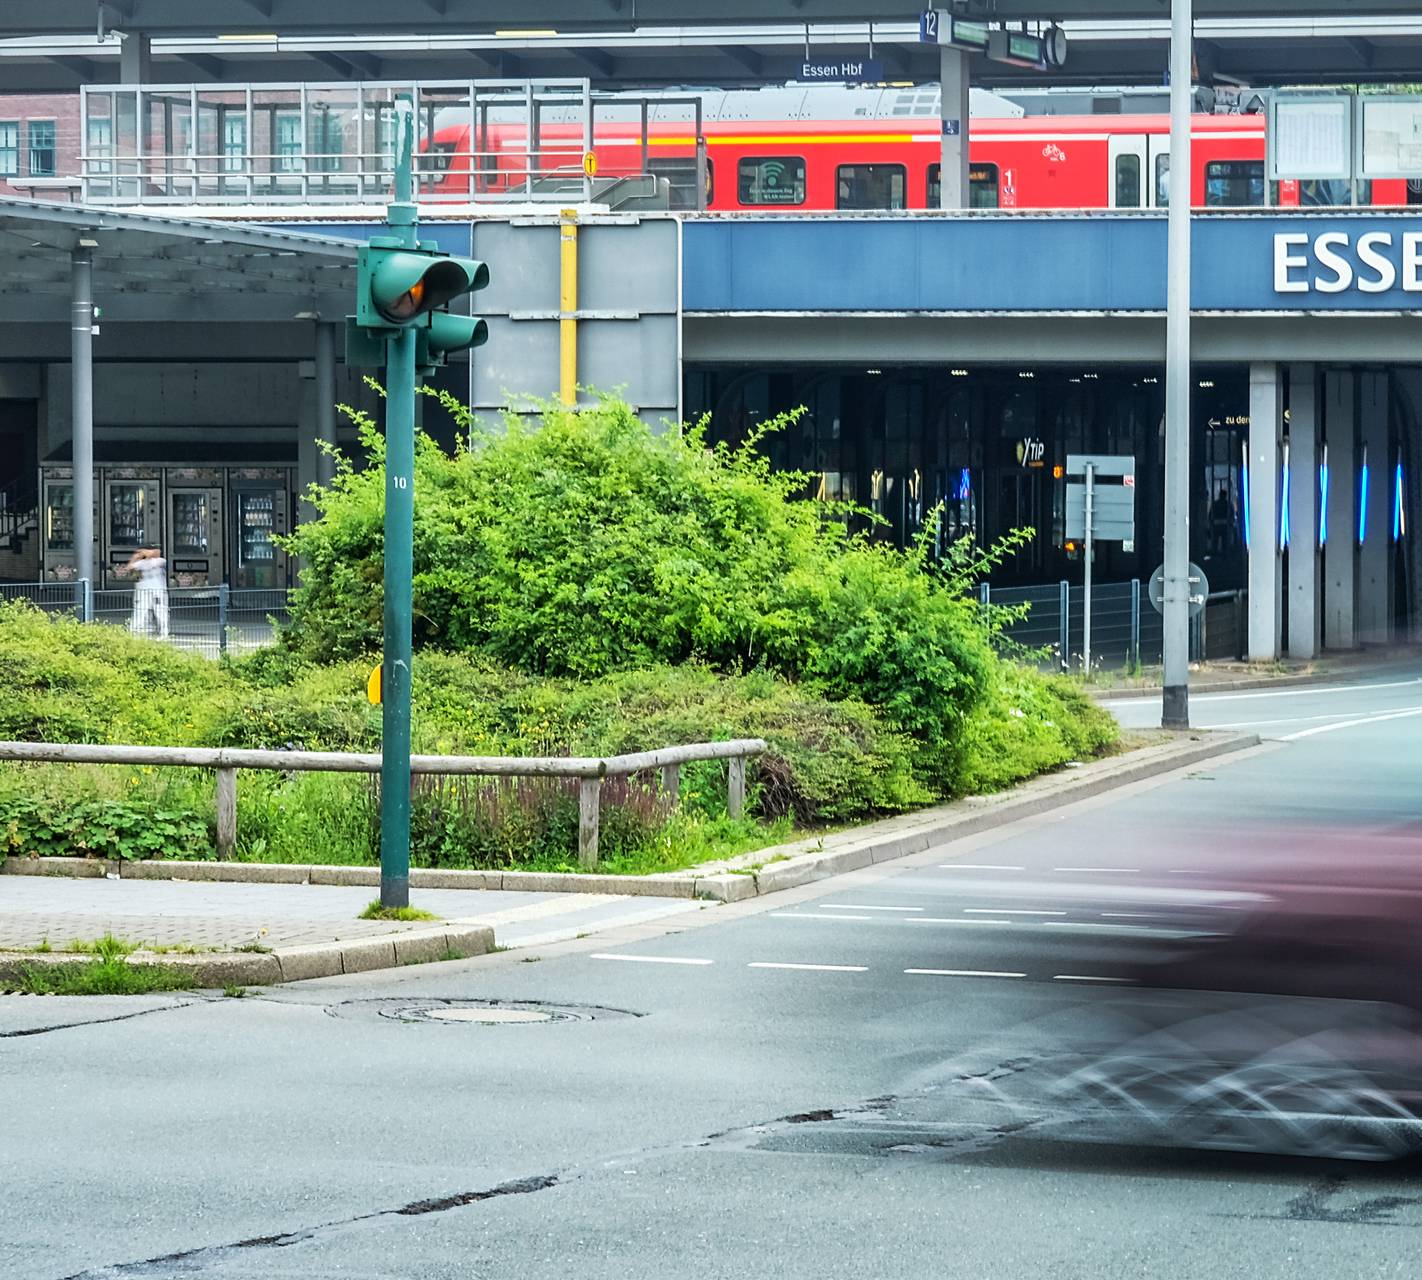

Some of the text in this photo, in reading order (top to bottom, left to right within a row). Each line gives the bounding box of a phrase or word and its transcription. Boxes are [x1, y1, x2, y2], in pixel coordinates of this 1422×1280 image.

[925, 11, 936, 36] 12
[802, 62, 863, 77] Essen Hbf
[1003, 168, 1013, 186] 1
[1225, 416, 1235, 425] zu
[393, 475, 407, 489] 10
